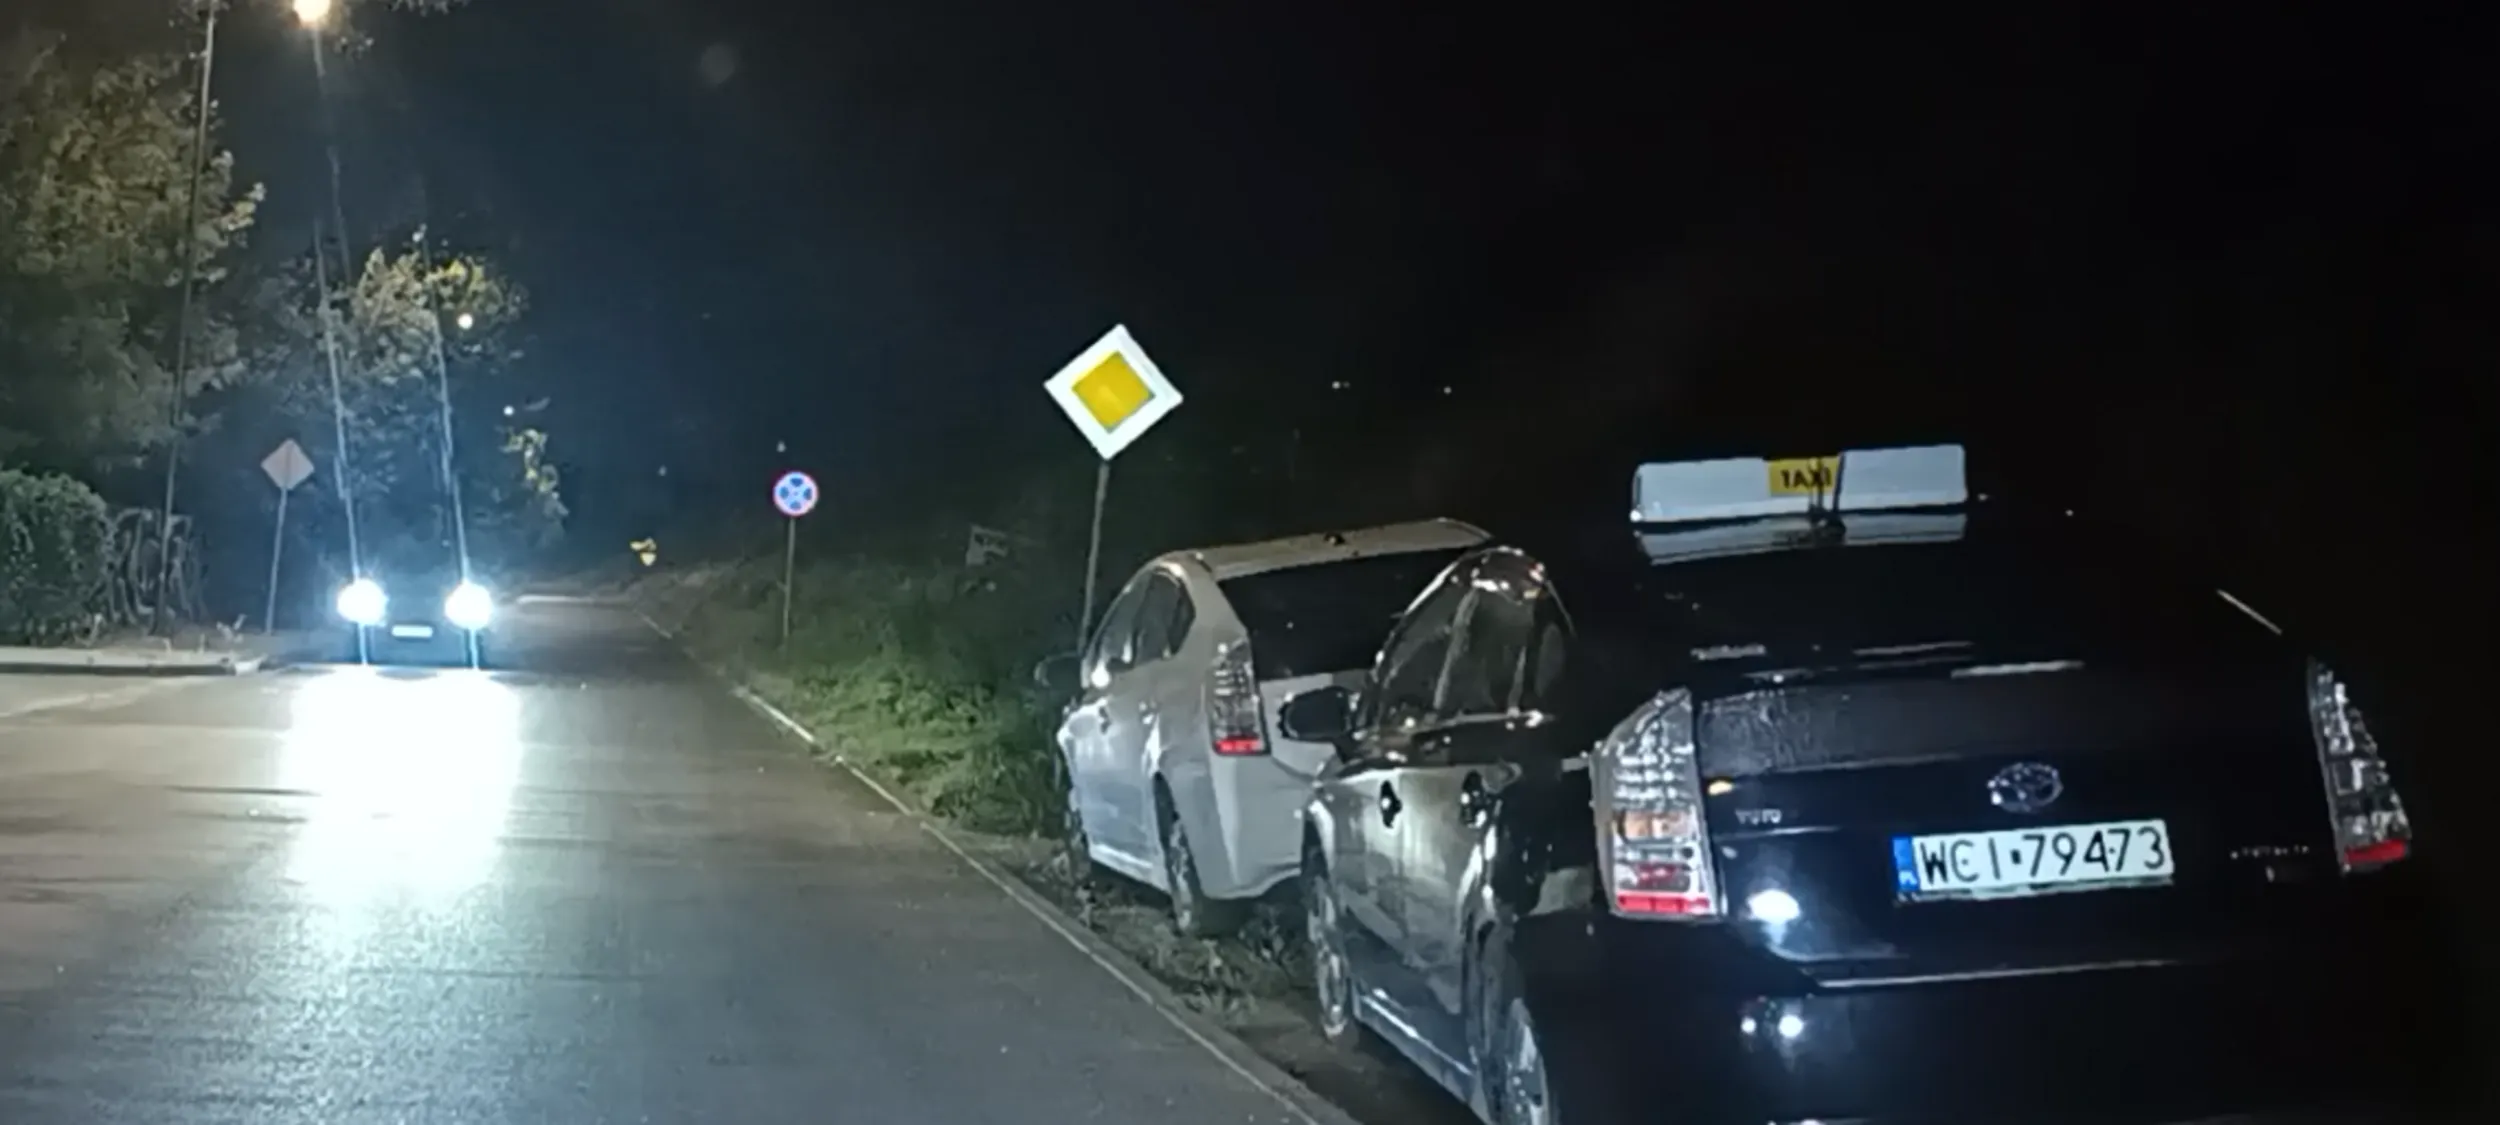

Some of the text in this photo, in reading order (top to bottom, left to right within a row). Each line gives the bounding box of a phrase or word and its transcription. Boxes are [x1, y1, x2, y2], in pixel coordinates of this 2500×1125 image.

[1780, 465, 1832, 490] TAXI
[1919, 825, 2166, 886] WCI 79473
